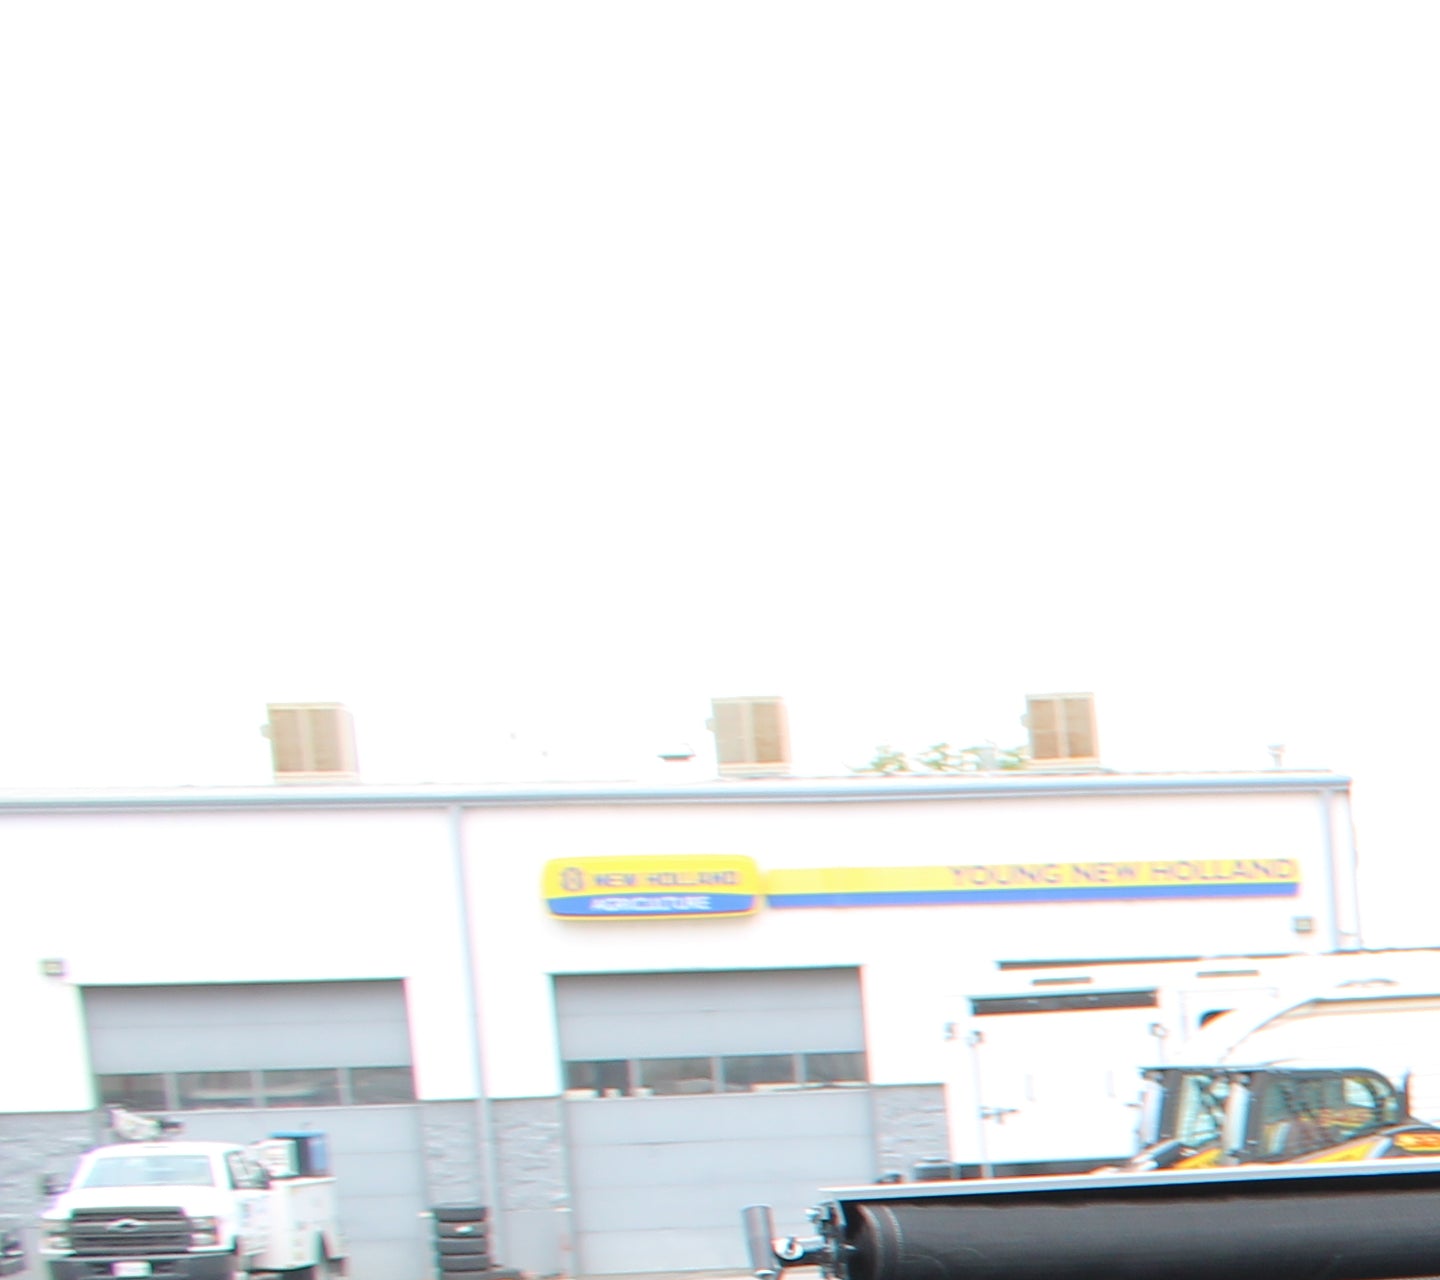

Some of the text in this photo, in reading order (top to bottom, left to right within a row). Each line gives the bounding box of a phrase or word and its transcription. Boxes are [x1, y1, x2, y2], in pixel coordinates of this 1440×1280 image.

[594, 870, 740, 887] NEW HOLLAND
[950, 859, 1297, 885] YOUNG NEW HOLLAND
